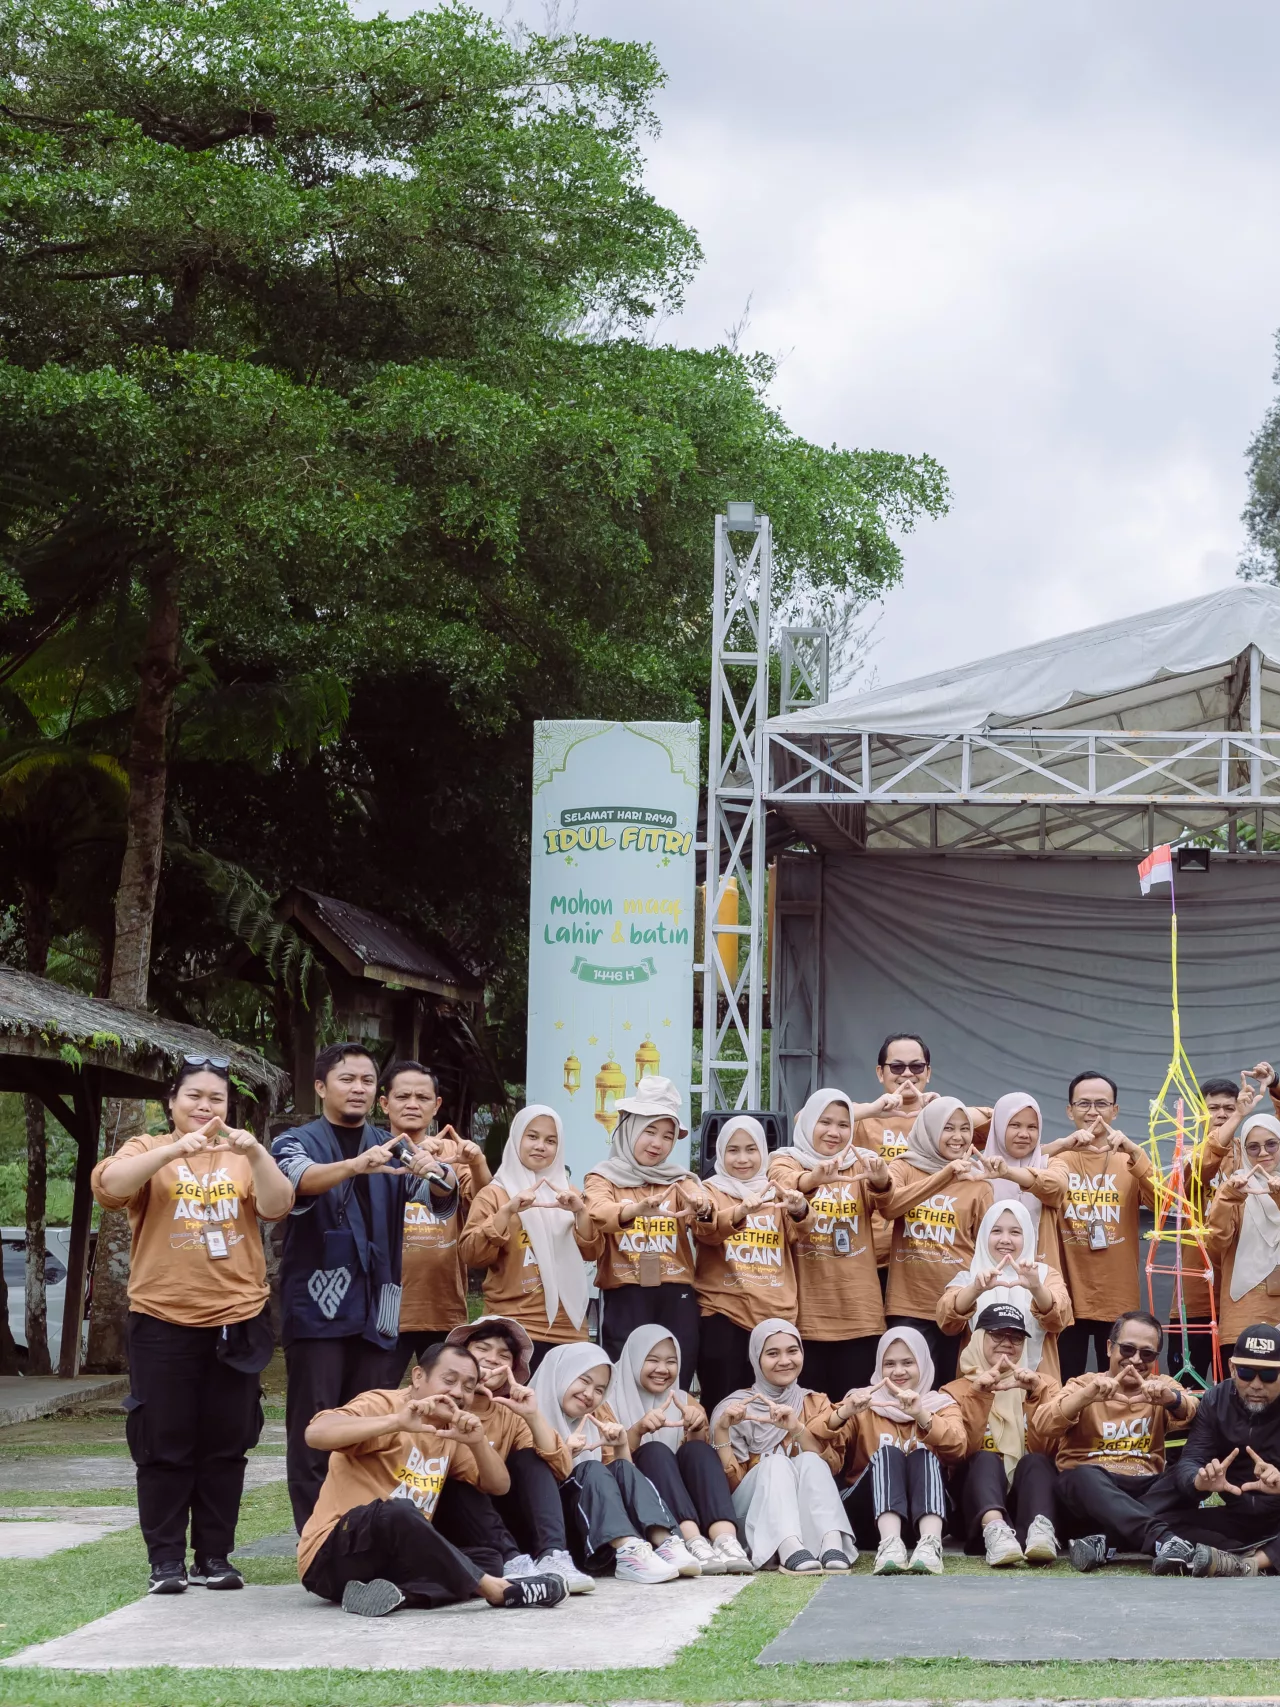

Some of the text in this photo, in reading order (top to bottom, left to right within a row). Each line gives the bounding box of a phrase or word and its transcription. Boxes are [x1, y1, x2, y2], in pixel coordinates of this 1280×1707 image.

[564, 810, 673, 825] SELAMAT HARI RAYA
[544, 826, 693, 855] IDUL FITRI
[550, 887, 683, 927] Mohon maaf
[544, 920, 689, 945] Lahir & batin
[593, 969, 635, 981] 1446 H
[883, 1129, 909, 1146] BA
[176, 1183, 236, 1198] 2GEHER
[1068, 1172, 1118, 1192] BACK
[814, 1183, 854, 1203] ACK
[174, 1197, 238, 1221] AGAIN
[810, 1201, 857, 1214] GETHER
[918, 1194, 958, 1213] ACK
[1064, 1202, 1121, 1224] AGAIN
[746, 1214, 778, 1232] ACK
[811, 1214, 858, 1235] GAN
[904, 1208, 955, 1224] GETHER
[727, 1231, 779, 1245] GETHER
[903, 1218, 956, 1246] AGAIN
[618, 1232, 677, 1254] AGAIN
[725, 1243, 782, 1266] AGAIN
[1103, 1416, 1151, 1440] BACK
[1097, 1438, 1151, 1450] 2GETHER
[398, 1469, 444, 1490] 2GETHE
